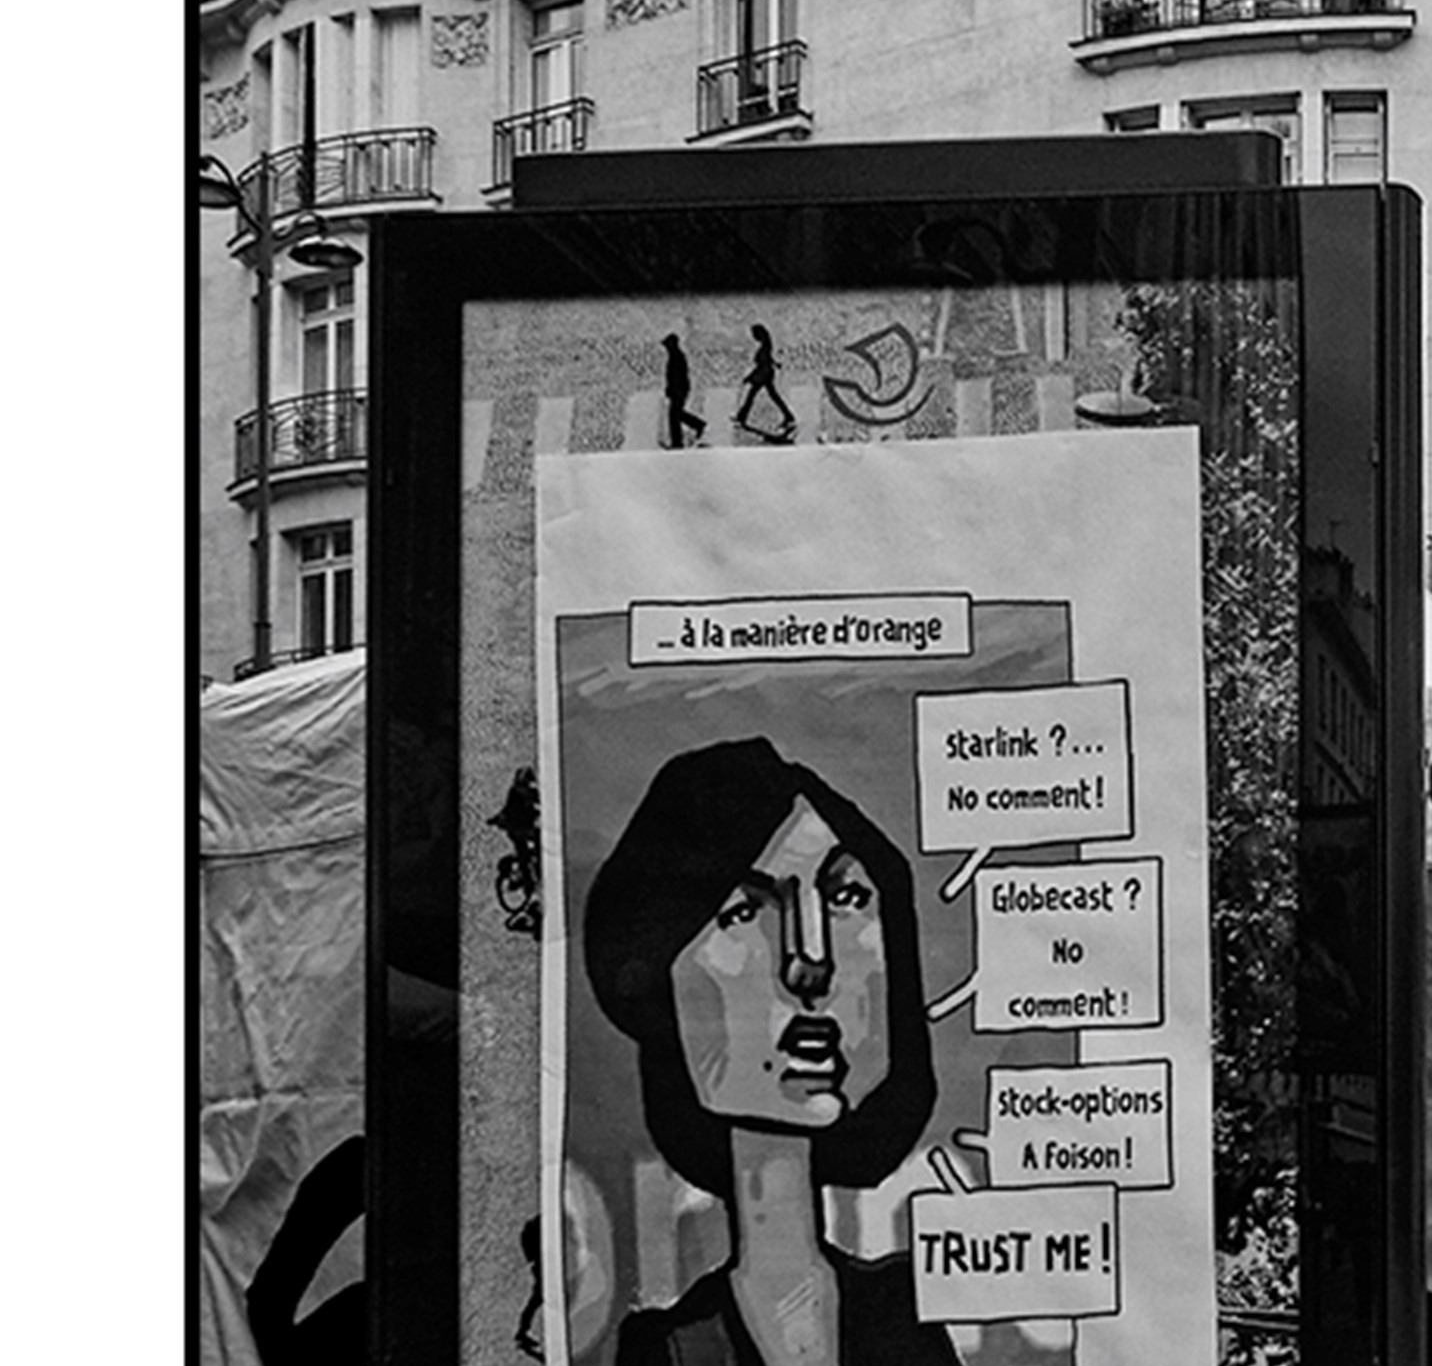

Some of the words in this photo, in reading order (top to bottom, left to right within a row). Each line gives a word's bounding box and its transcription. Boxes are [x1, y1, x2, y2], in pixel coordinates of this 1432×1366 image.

[681, 618, 695, 648] à
[703, 618, 723, 648] la
[730, 614, 827, 647] manière
[948, 786, 980, 811] No
[992, 881, 1113, 913] Globecast
[1123, 877, 1141, 911] ?
[1022, 1142, 1038, 1169] A
[918, 1231, 1033, 1276] TRUST
